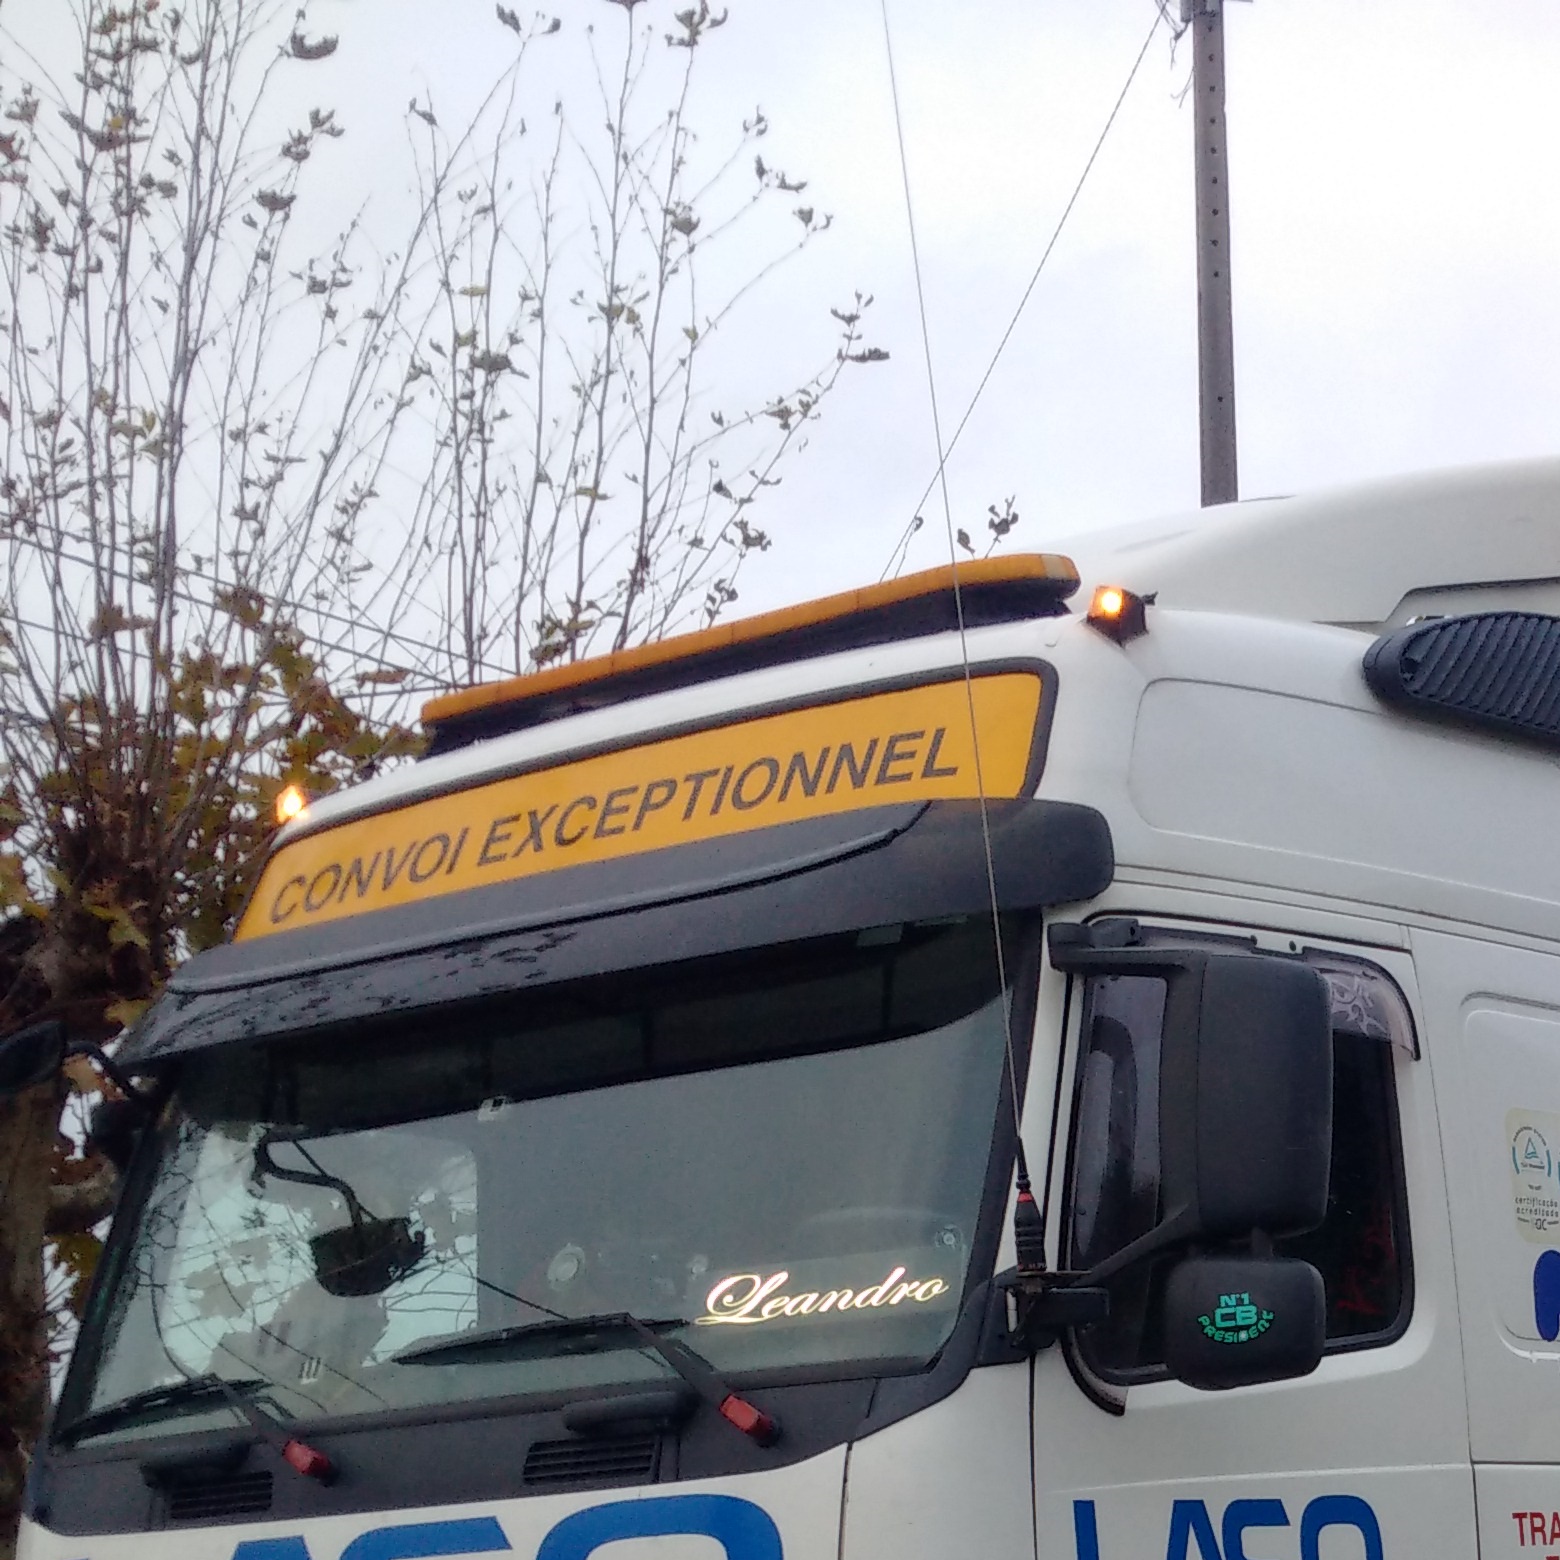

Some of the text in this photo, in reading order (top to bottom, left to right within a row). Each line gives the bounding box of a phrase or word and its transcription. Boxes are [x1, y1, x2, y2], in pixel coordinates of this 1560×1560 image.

[270, 726, 960, 926] CONVOI EXCEPTIONNEL
[695, 1267, 949, 1326] Leandro
[1214, 1305, 1258, 1328] CB
